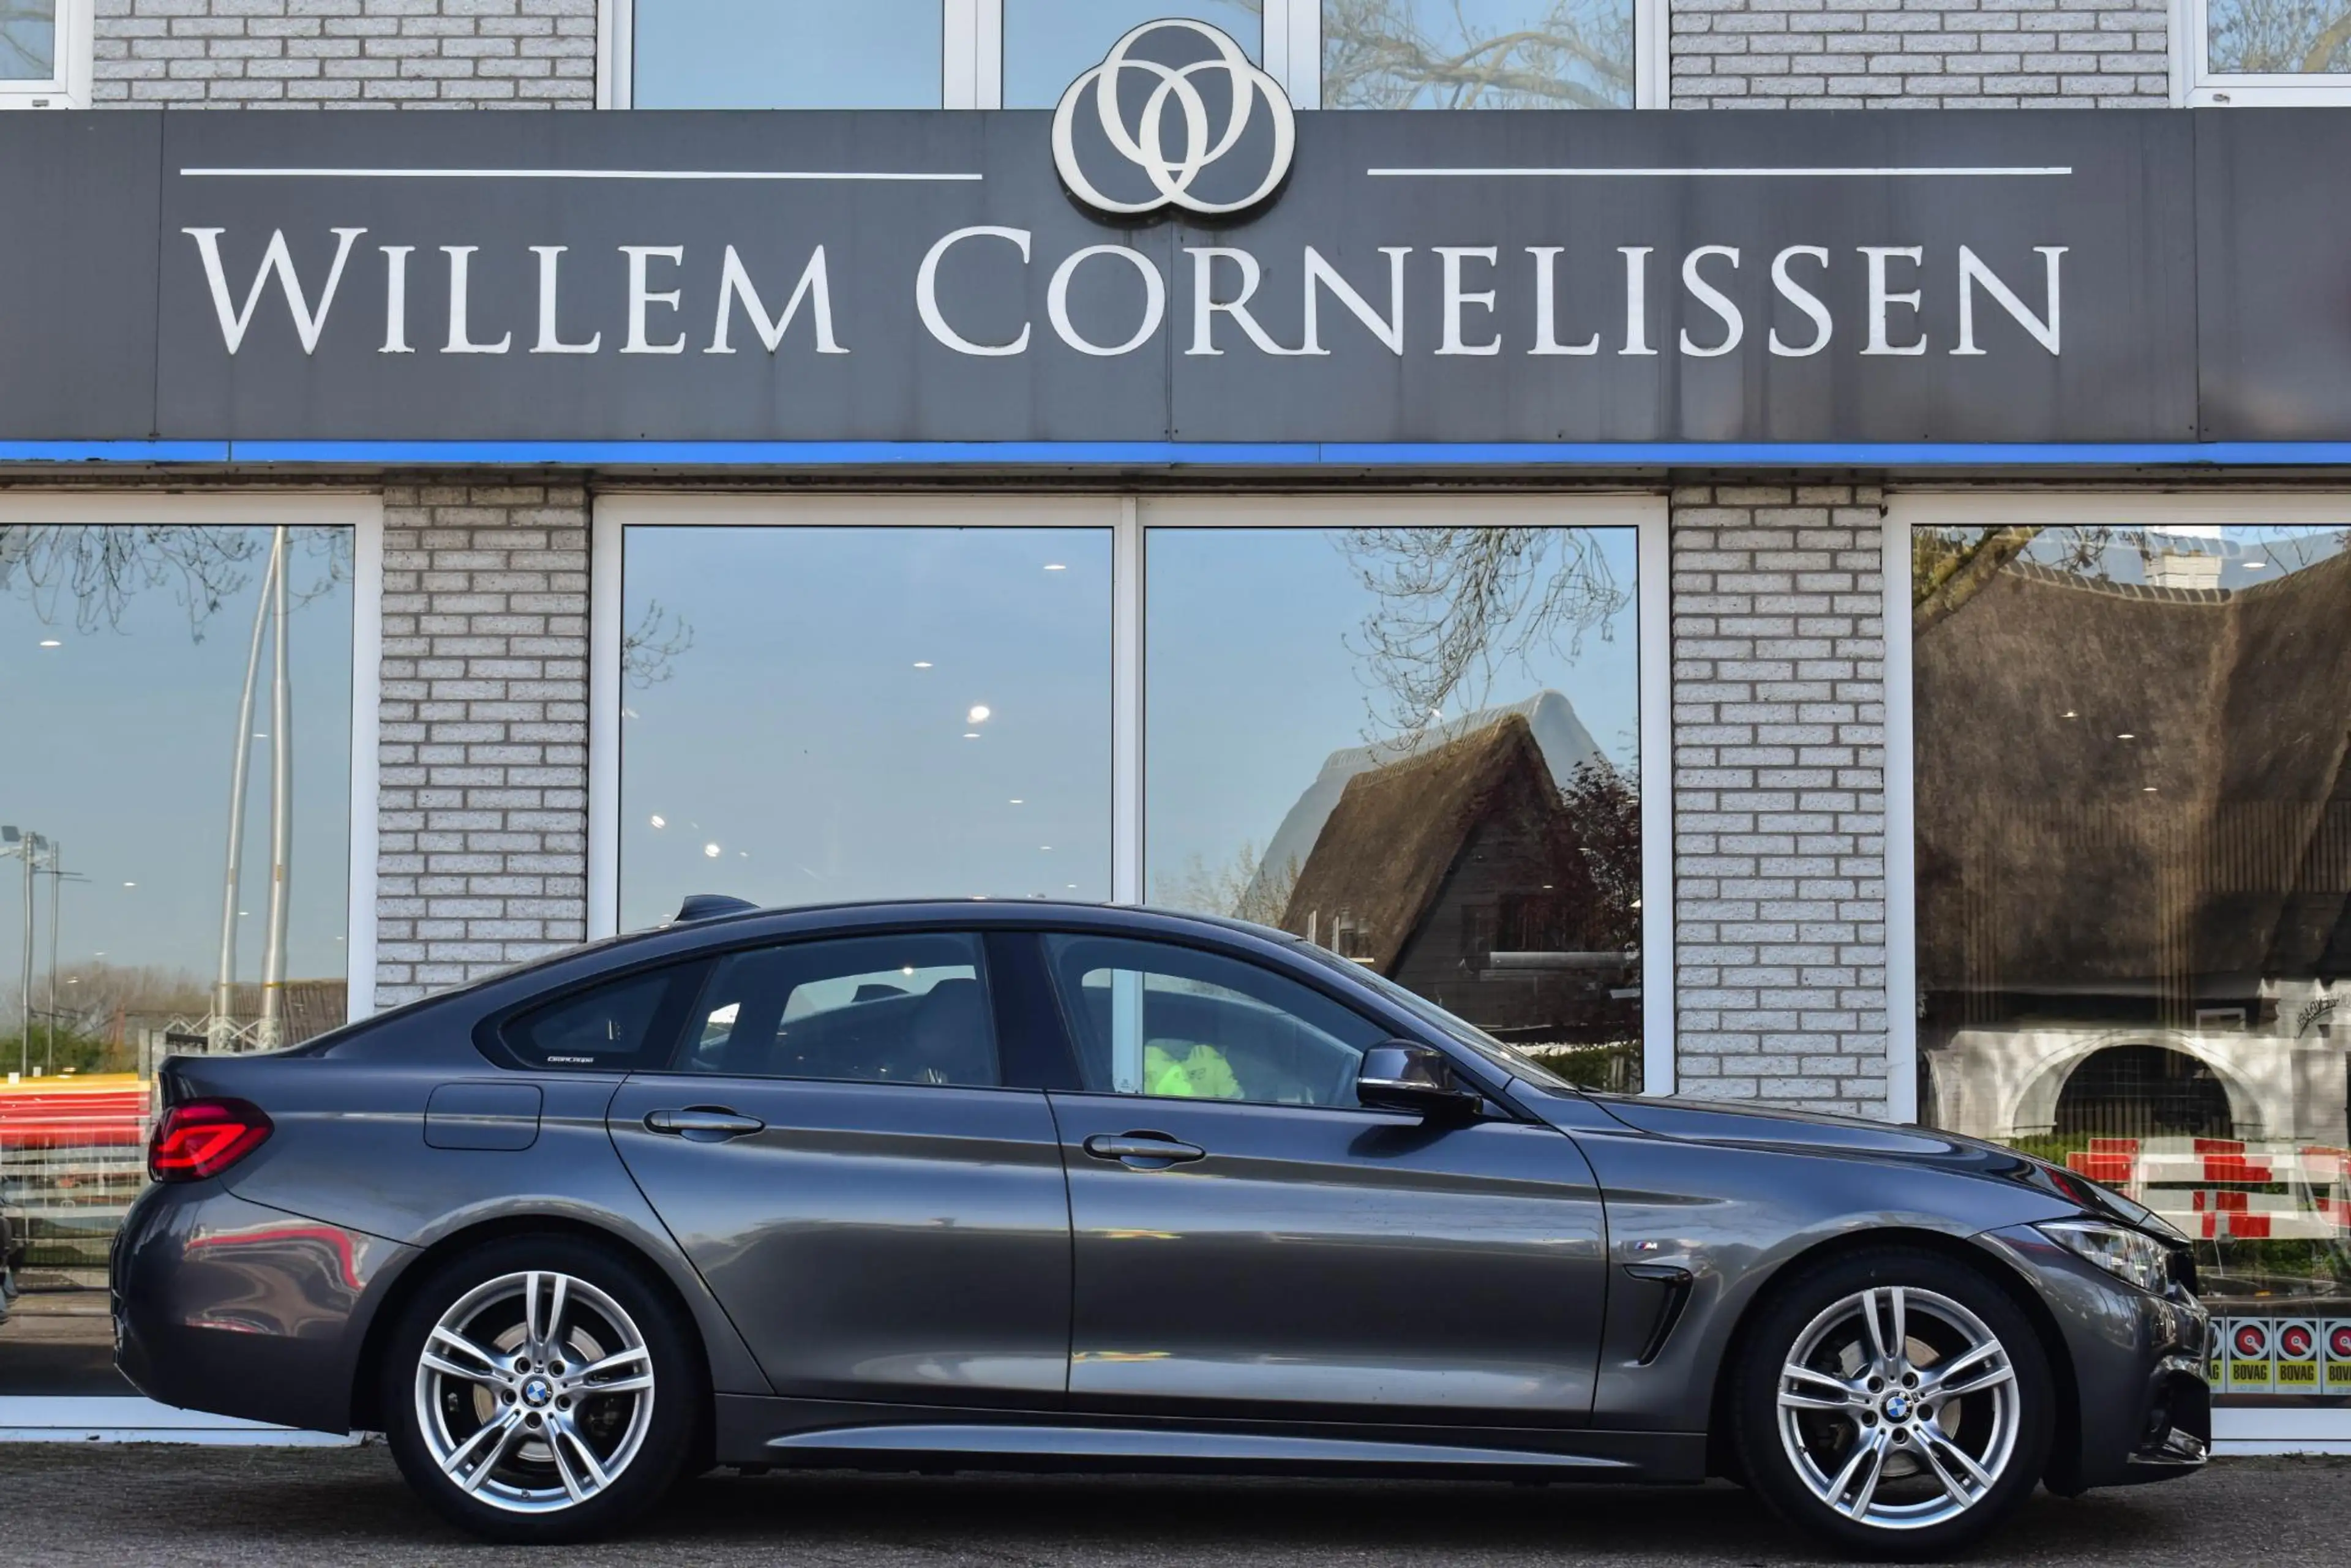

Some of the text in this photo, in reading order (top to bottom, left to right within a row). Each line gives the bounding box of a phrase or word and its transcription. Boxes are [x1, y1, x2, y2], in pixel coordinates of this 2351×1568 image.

[181, 226, 2069, 357] WILLEM CORNELISSEN
[2233, 1364, 2267, 1381] BOVAG
[2279, 1365, 2315, 1381] BOVAG
